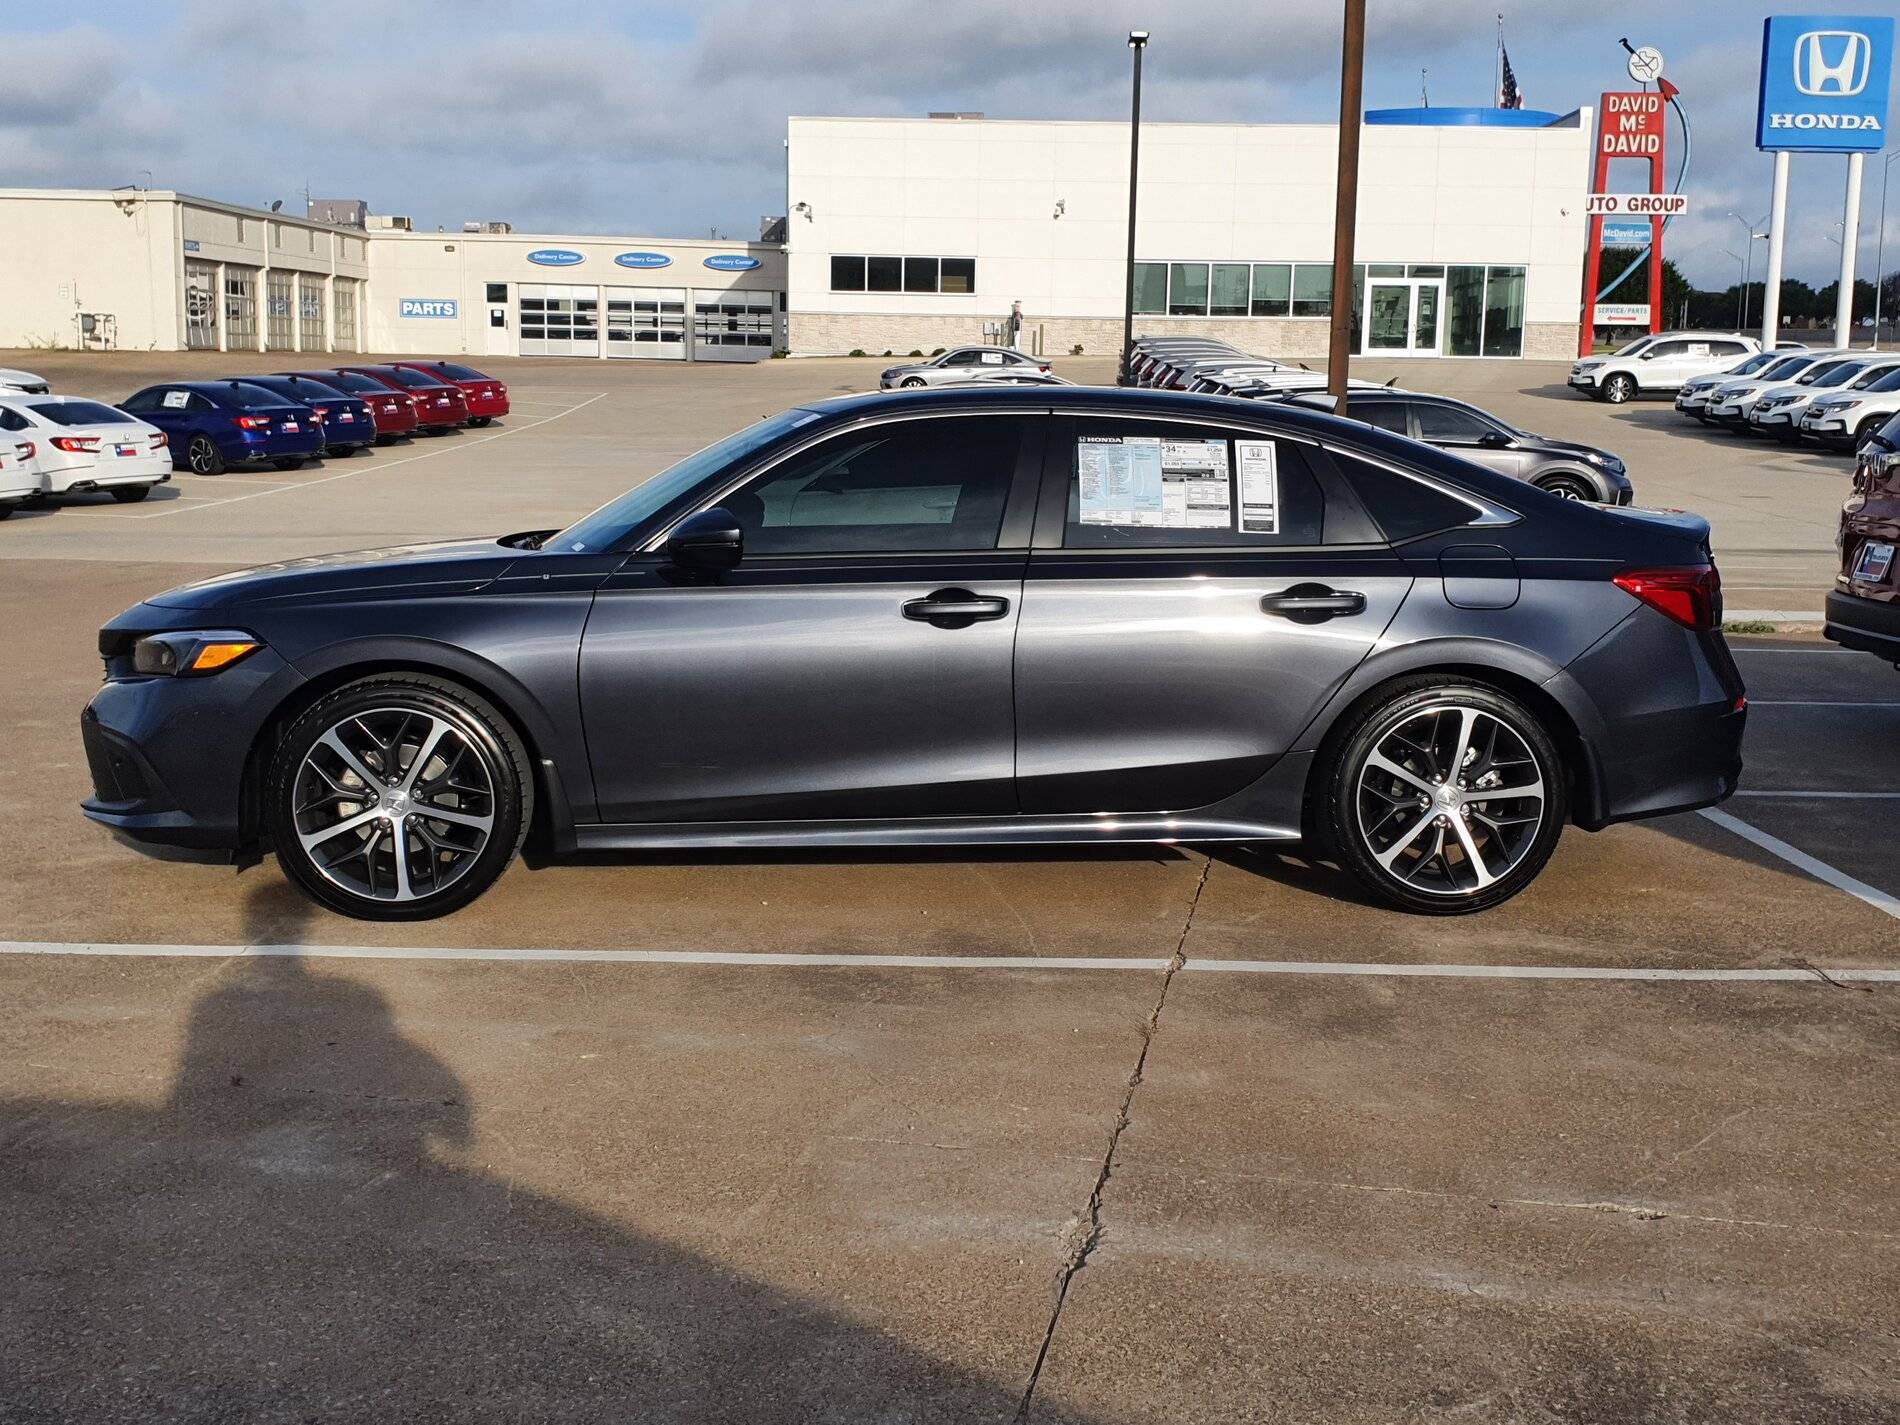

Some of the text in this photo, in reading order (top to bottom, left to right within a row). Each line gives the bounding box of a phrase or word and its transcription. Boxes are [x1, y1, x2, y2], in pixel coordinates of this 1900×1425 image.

[1609, 96, 1659, 112] DAVID
[1769, 113, 1882, 130] HONDA
[1603, 134, 1660, 153] DAVID
[1627, 197, 1685, 212] GROUP
[1604, 229, 1650, 238] McDavid.com
[402, 302, 454, 316] PARTS
